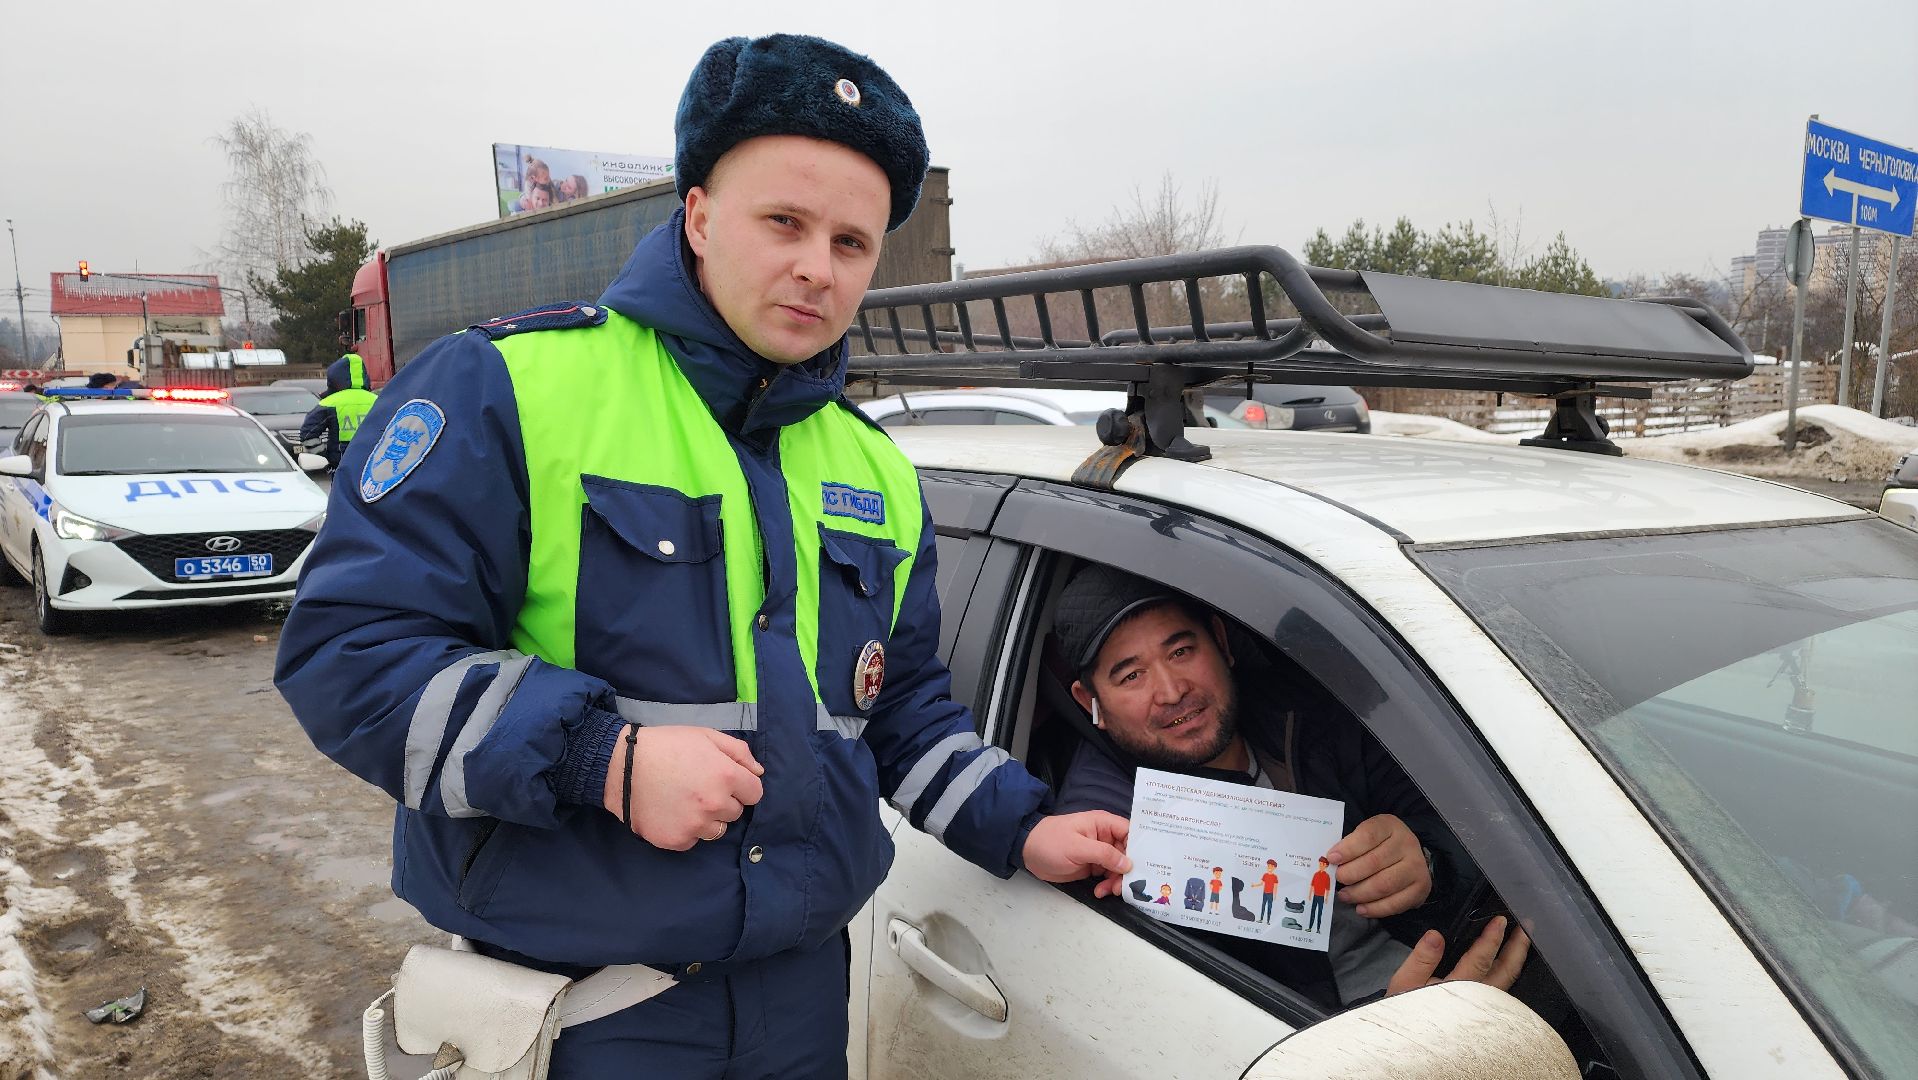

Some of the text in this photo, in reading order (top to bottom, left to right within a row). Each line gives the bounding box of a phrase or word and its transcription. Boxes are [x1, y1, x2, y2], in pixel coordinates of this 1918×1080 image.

[1807, 133, 1850, 164] МОСКВА
[125, 478, 282, 503] ДПС
[842, 491, 880, 516] ГИБДД
[201, 557, 242, 573] 5346
[251, 555, 267, 566] 50
